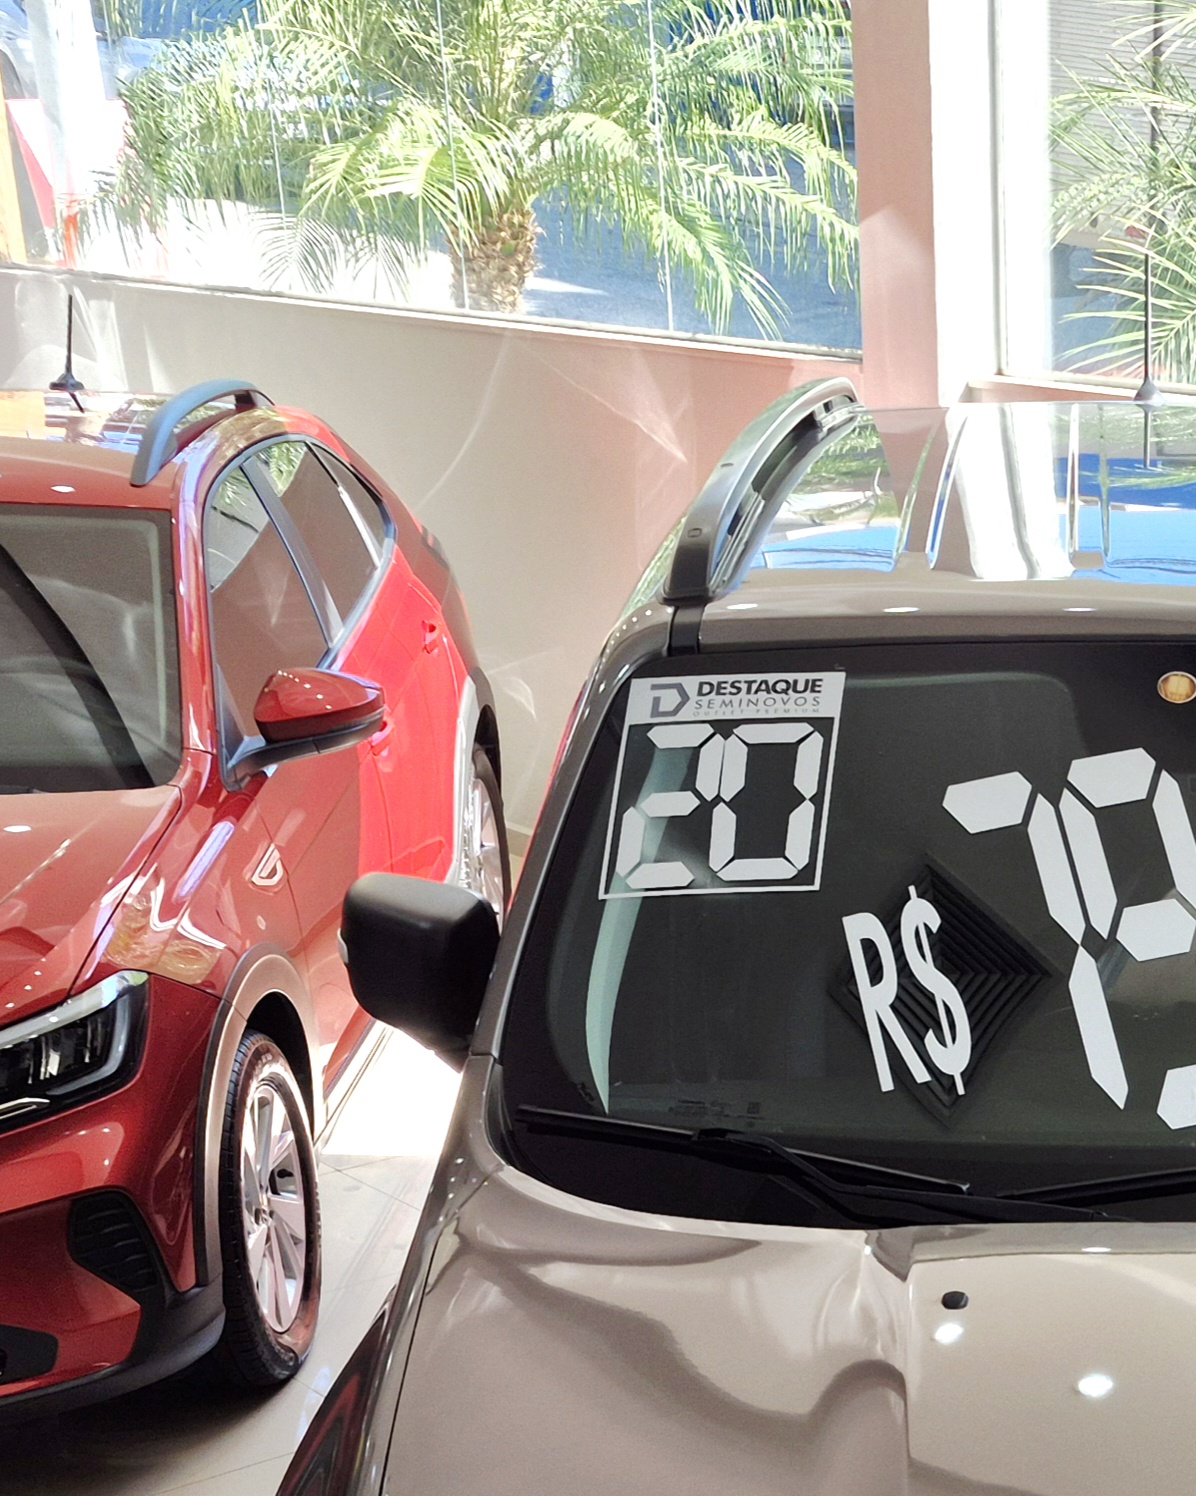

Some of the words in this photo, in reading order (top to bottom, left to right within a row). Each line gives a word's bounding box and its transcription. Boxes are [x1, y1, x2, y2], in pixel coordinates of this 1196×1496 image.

[694, 696, 821, 709] SEMINOVOS
[696, 678, 824, 697] DESTAQUE
[616, 722, 824, 889] 20
[841, 885, 973, 1096] R$
